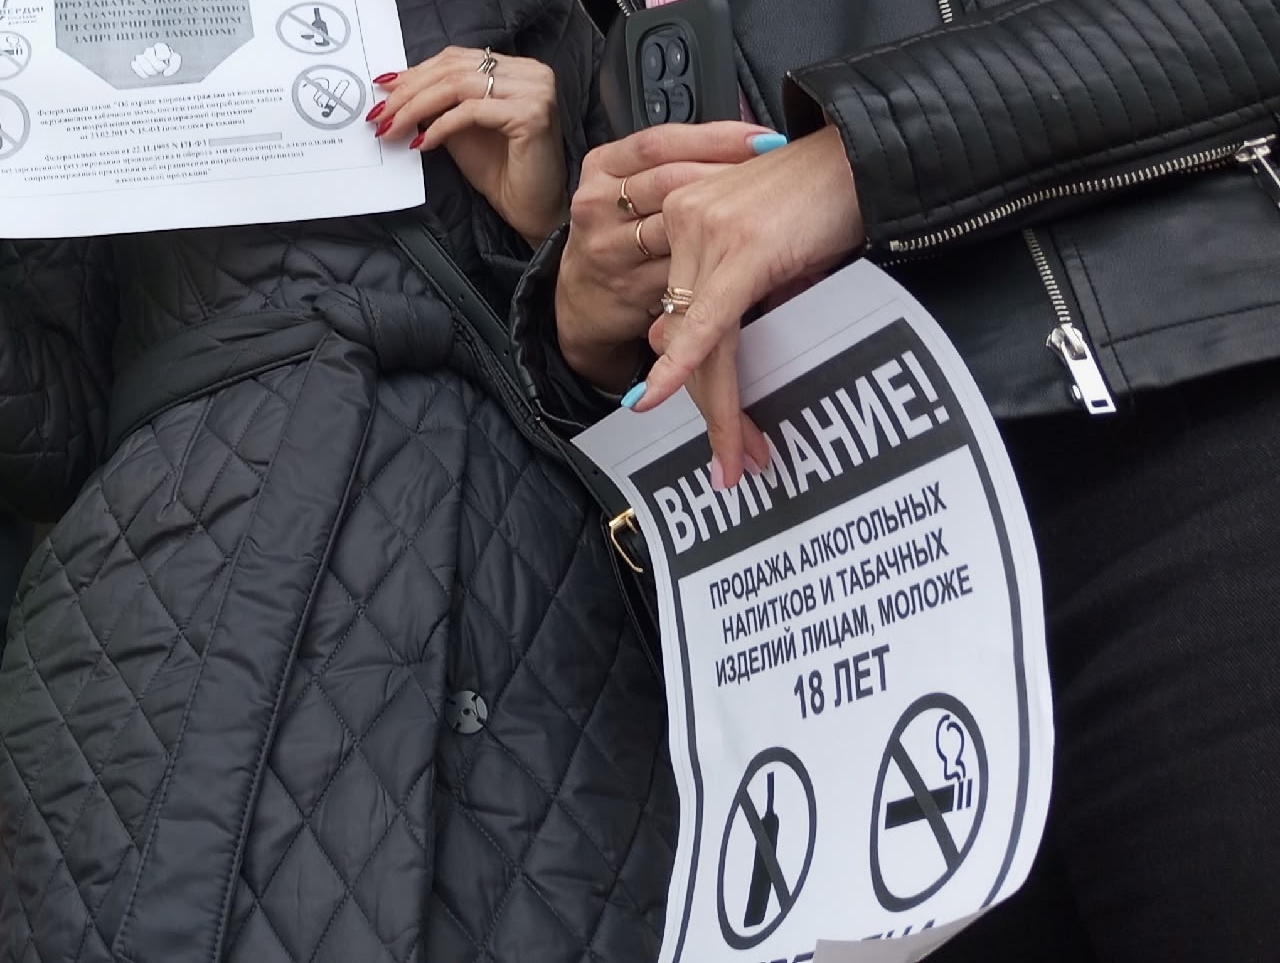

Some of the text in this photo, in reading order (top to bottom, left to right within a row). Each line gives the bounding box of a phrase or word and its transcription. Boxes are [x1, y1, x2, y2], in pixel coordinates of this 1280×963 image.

[652, 349, 950, 555] ВНИМАНИЕ!
[709, 481, 947, 610] ПРОДАЖА АЛКОГОЛЬНЫХ
[721, 527, 950, 645] НАПИТКОВ И ТАБАЧНЫХ
[715, 563, 973, 688] ИЗДЕЛИЙ ЛИЦАМ, МОЛОЖЕ
[793, 643, 891, 719] 18 ЛЕТ
